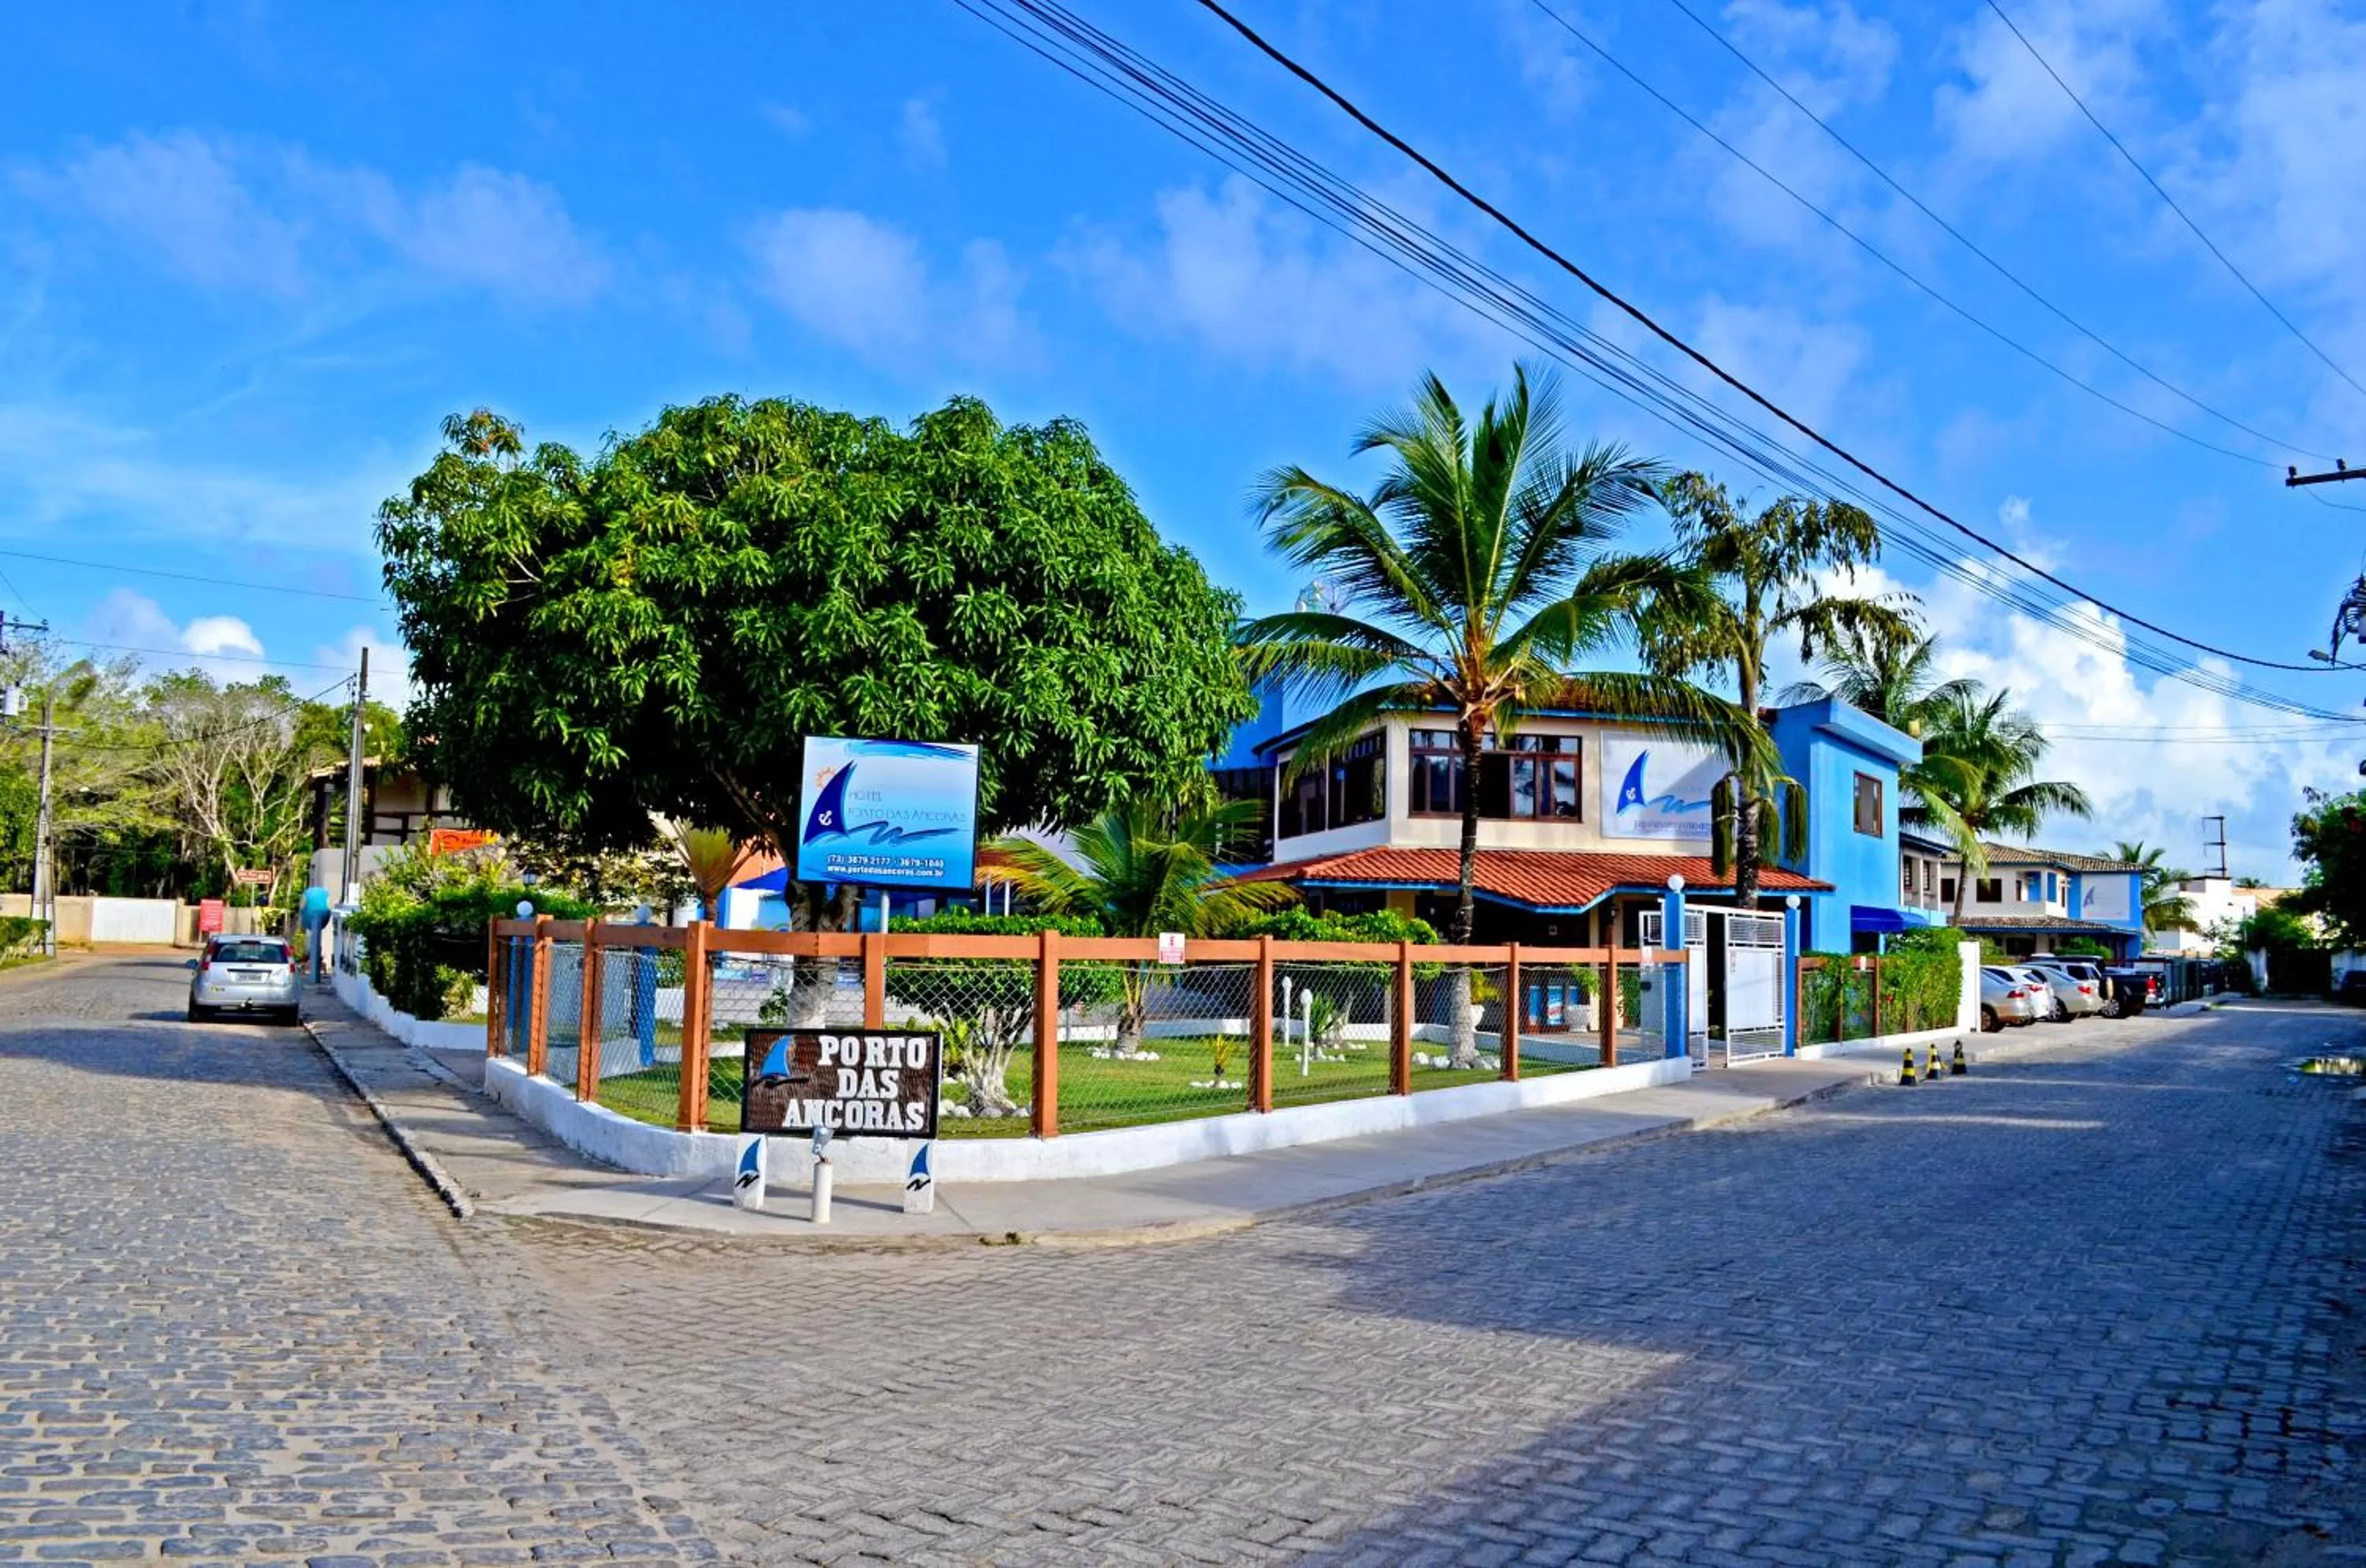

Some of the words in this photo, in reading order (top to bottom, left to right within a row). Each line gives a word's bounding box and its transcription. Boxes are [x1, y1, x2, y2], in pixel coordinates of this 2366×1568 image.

[849, 790, 883, 801] HOTEL
[886, 808, 909, 819] DAS
[817, 1035, 927, 1070] PORTO
[835, 1068, 900, 1099] DAS
[782, 1098, 925, 1131] ANCORAS
